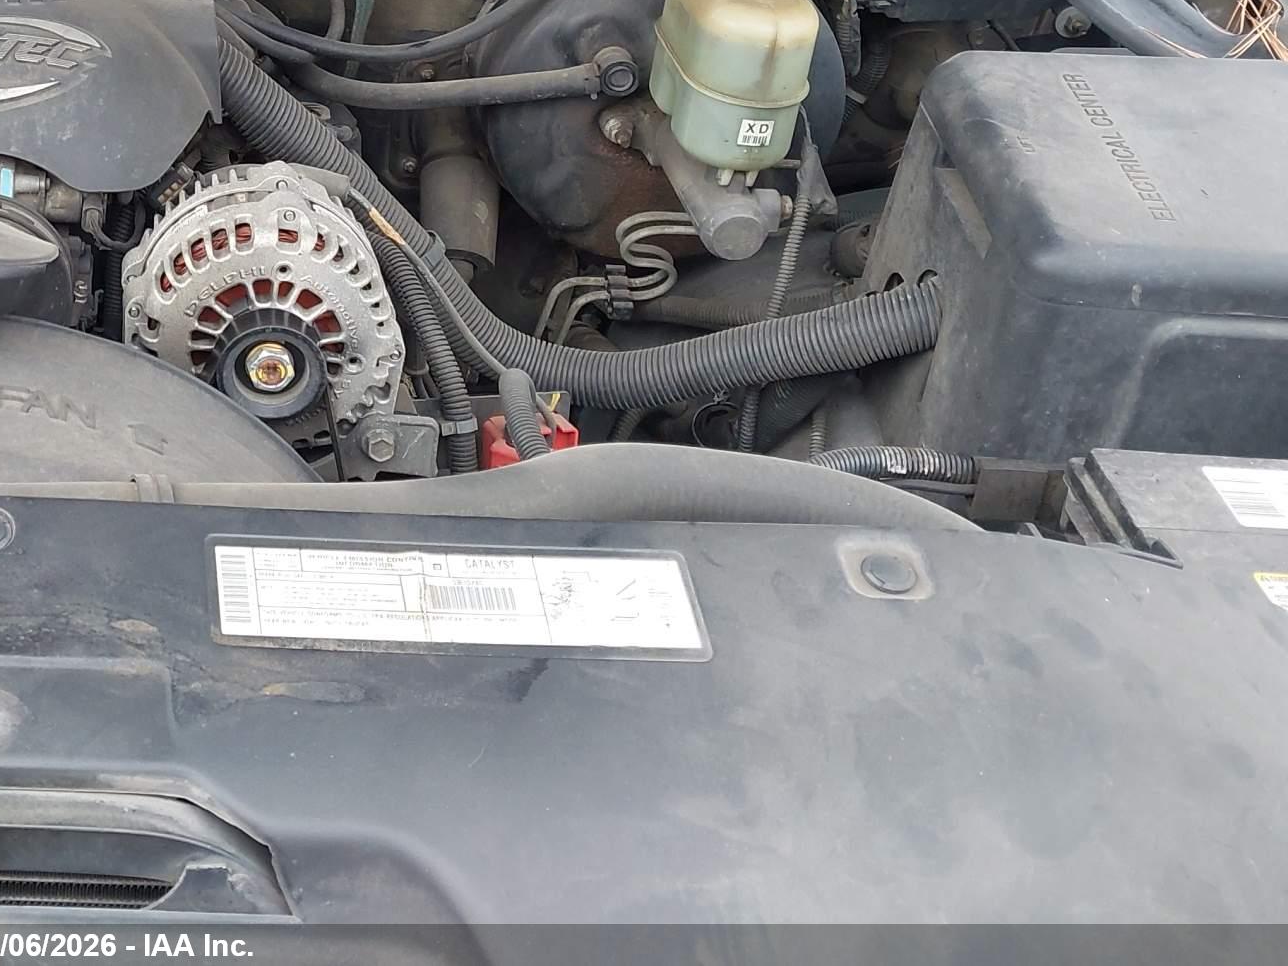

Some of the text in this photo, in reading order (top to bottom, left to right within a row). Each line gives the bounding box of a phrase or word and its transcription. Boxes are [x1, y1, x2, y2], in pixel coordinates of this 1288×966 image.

[1062, 73, 1177, 222] ELECTRICAL CENTER
[184, 265, 266, 318] DELPHI
[464, 558, 515, 570] CATALYST
